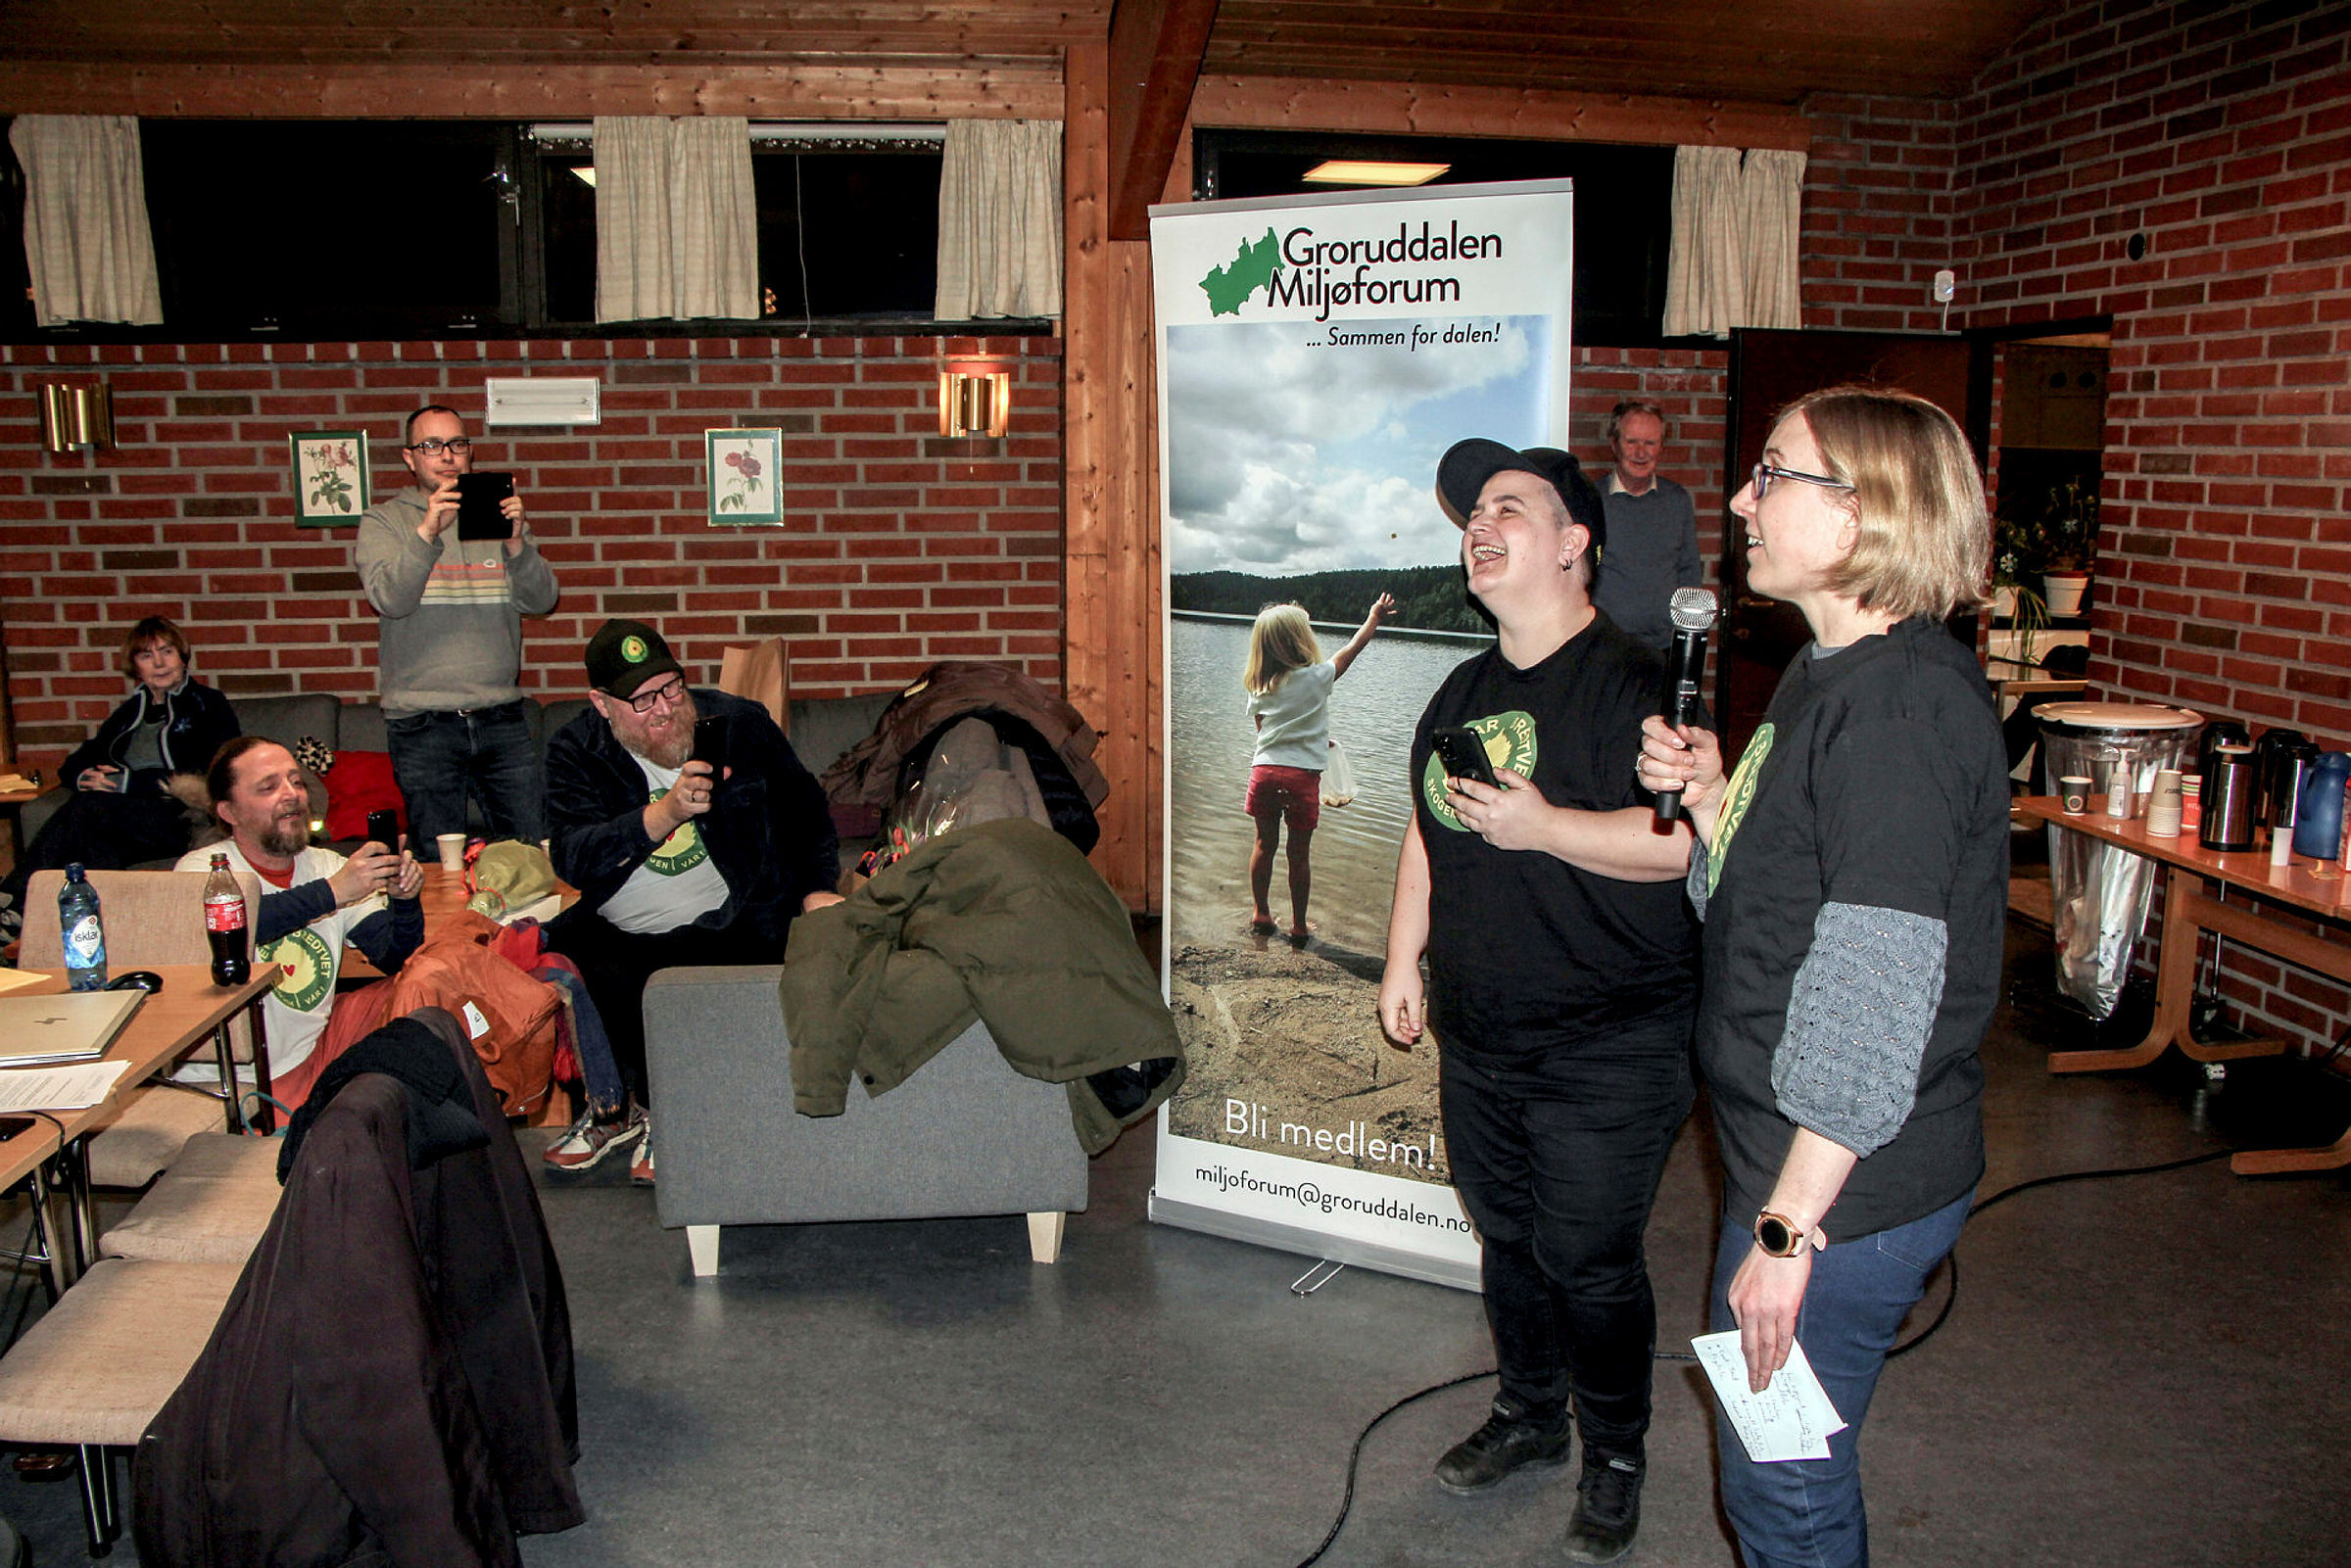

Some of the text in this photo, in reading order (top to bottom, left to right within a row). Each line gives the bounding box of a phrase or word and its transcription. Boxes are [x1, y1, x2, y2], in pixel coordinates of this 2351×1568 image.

[1283, 220, 1503, 266] Groruddalen
[1267, 265, 1461, 322] Miljøforum
[1327, 327, 1406, 347] Sammen
[1411, 324, 1439, 352] for
[1443, 322, 1501, 345] dalen!
[1225, 1098, 1436, 1170] Bli medlem!
[1196, 1165, 1471, 1233] miljoforum@groruddalen.no
